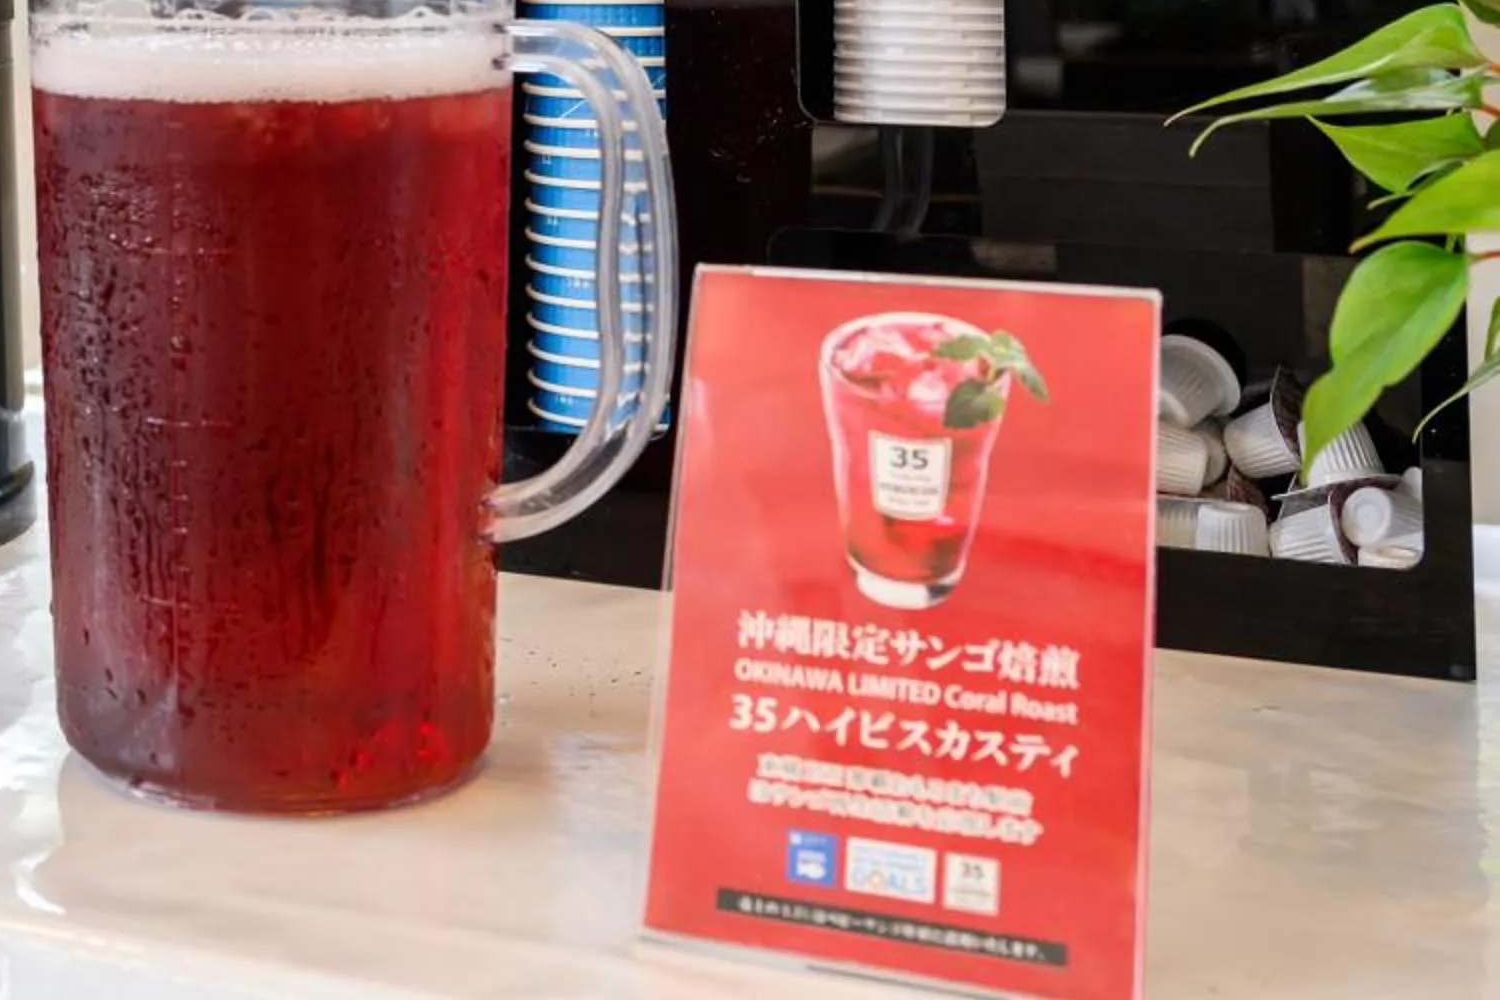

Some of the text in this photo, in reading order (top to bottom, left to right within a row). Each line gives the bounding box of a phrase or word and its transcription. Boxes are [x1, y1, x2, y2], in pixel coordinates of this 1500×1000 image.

[889, 445, 930, 470] 35
[736, 609, 1082, 691] 沖縄限定サンゴ焙煎
[733, 658, 1079, 726] OKINAWA LIMITED Coral Roast
